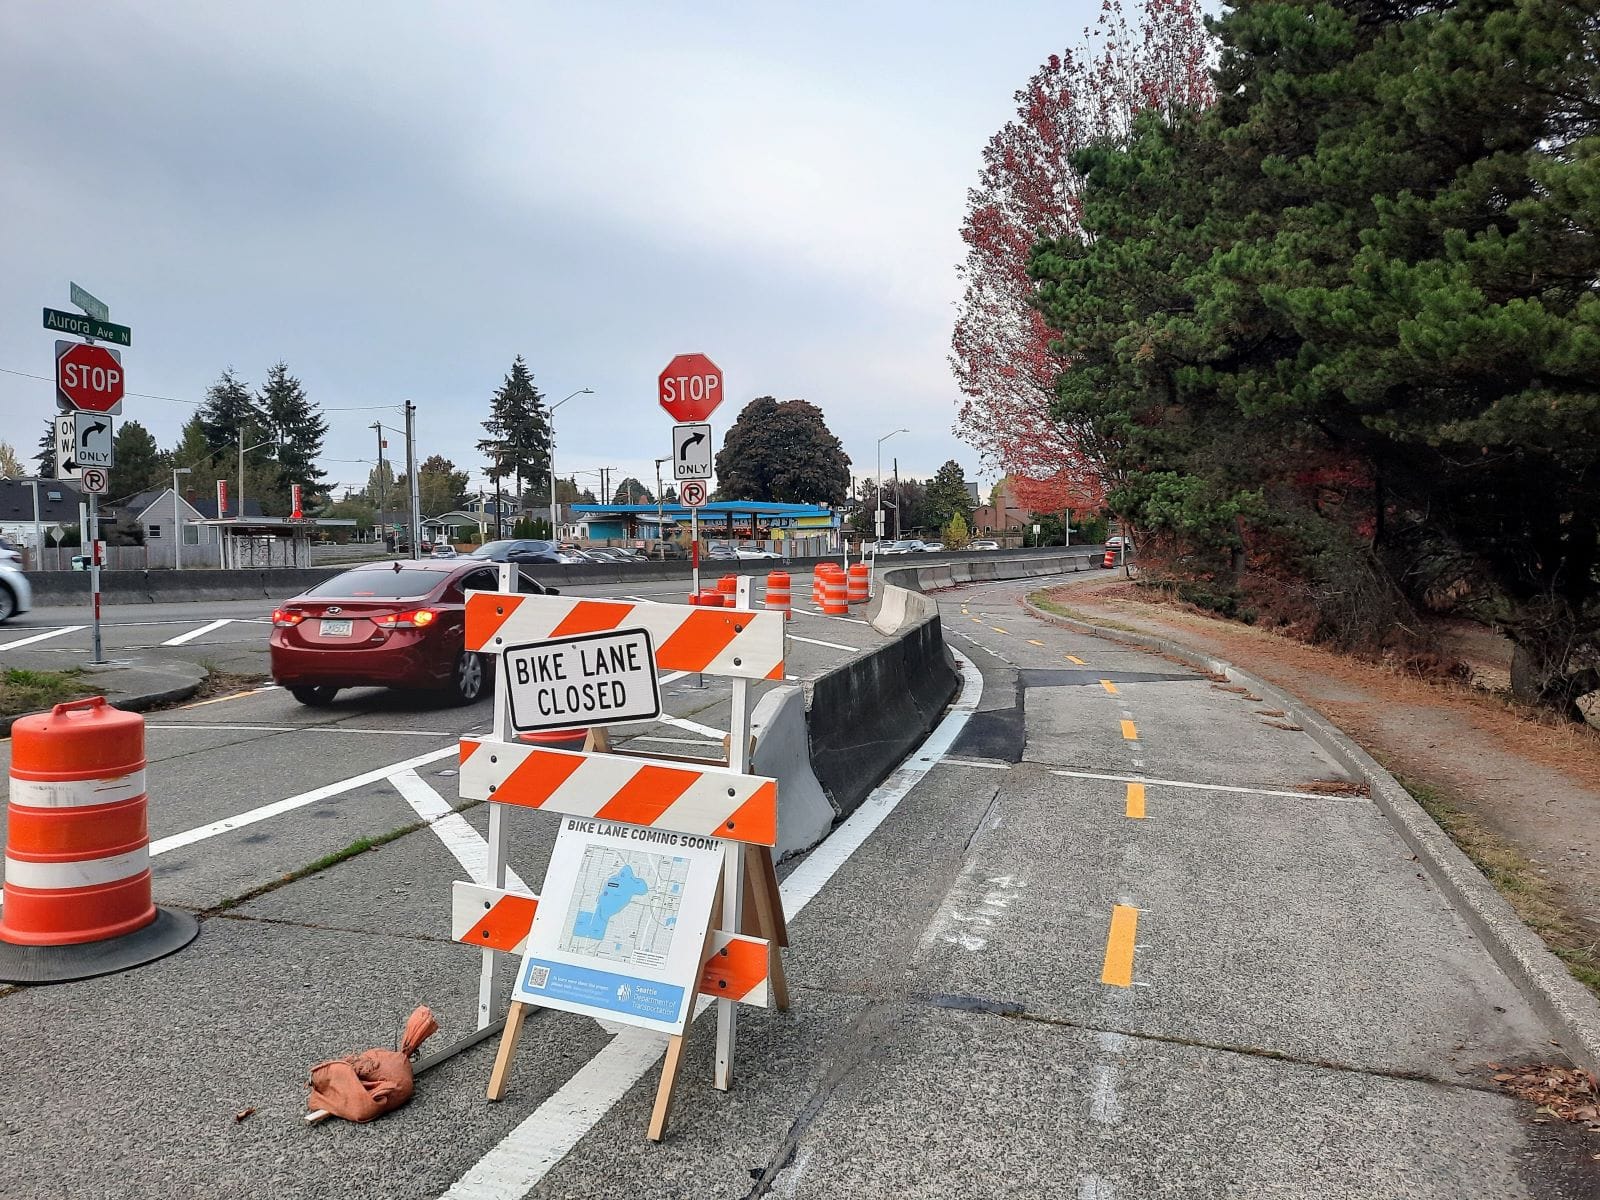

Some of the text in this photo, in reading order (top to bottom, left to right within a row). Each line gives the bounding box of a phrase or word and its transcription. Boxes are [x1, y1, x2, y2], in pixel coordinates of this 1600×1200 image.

[47, 311, 128, 343] Aurora Ave N
[64, 362, 120, 393] STOP
[663, 374, 719, 402] STOP
[61, 421, 75, 435] ON
[61, 438, 75, 453] WA
[79, 450, 110, 462] ONLY
[678, 463, 708, 475] ONLY
[515, 642, 642, 685] BIKE LANE
[537, 680, 626, 716] CLOSED
[567, 819, 719, 852] BIKE LANE COMING SOON!
[635, 985, 658, 996] Seattle
